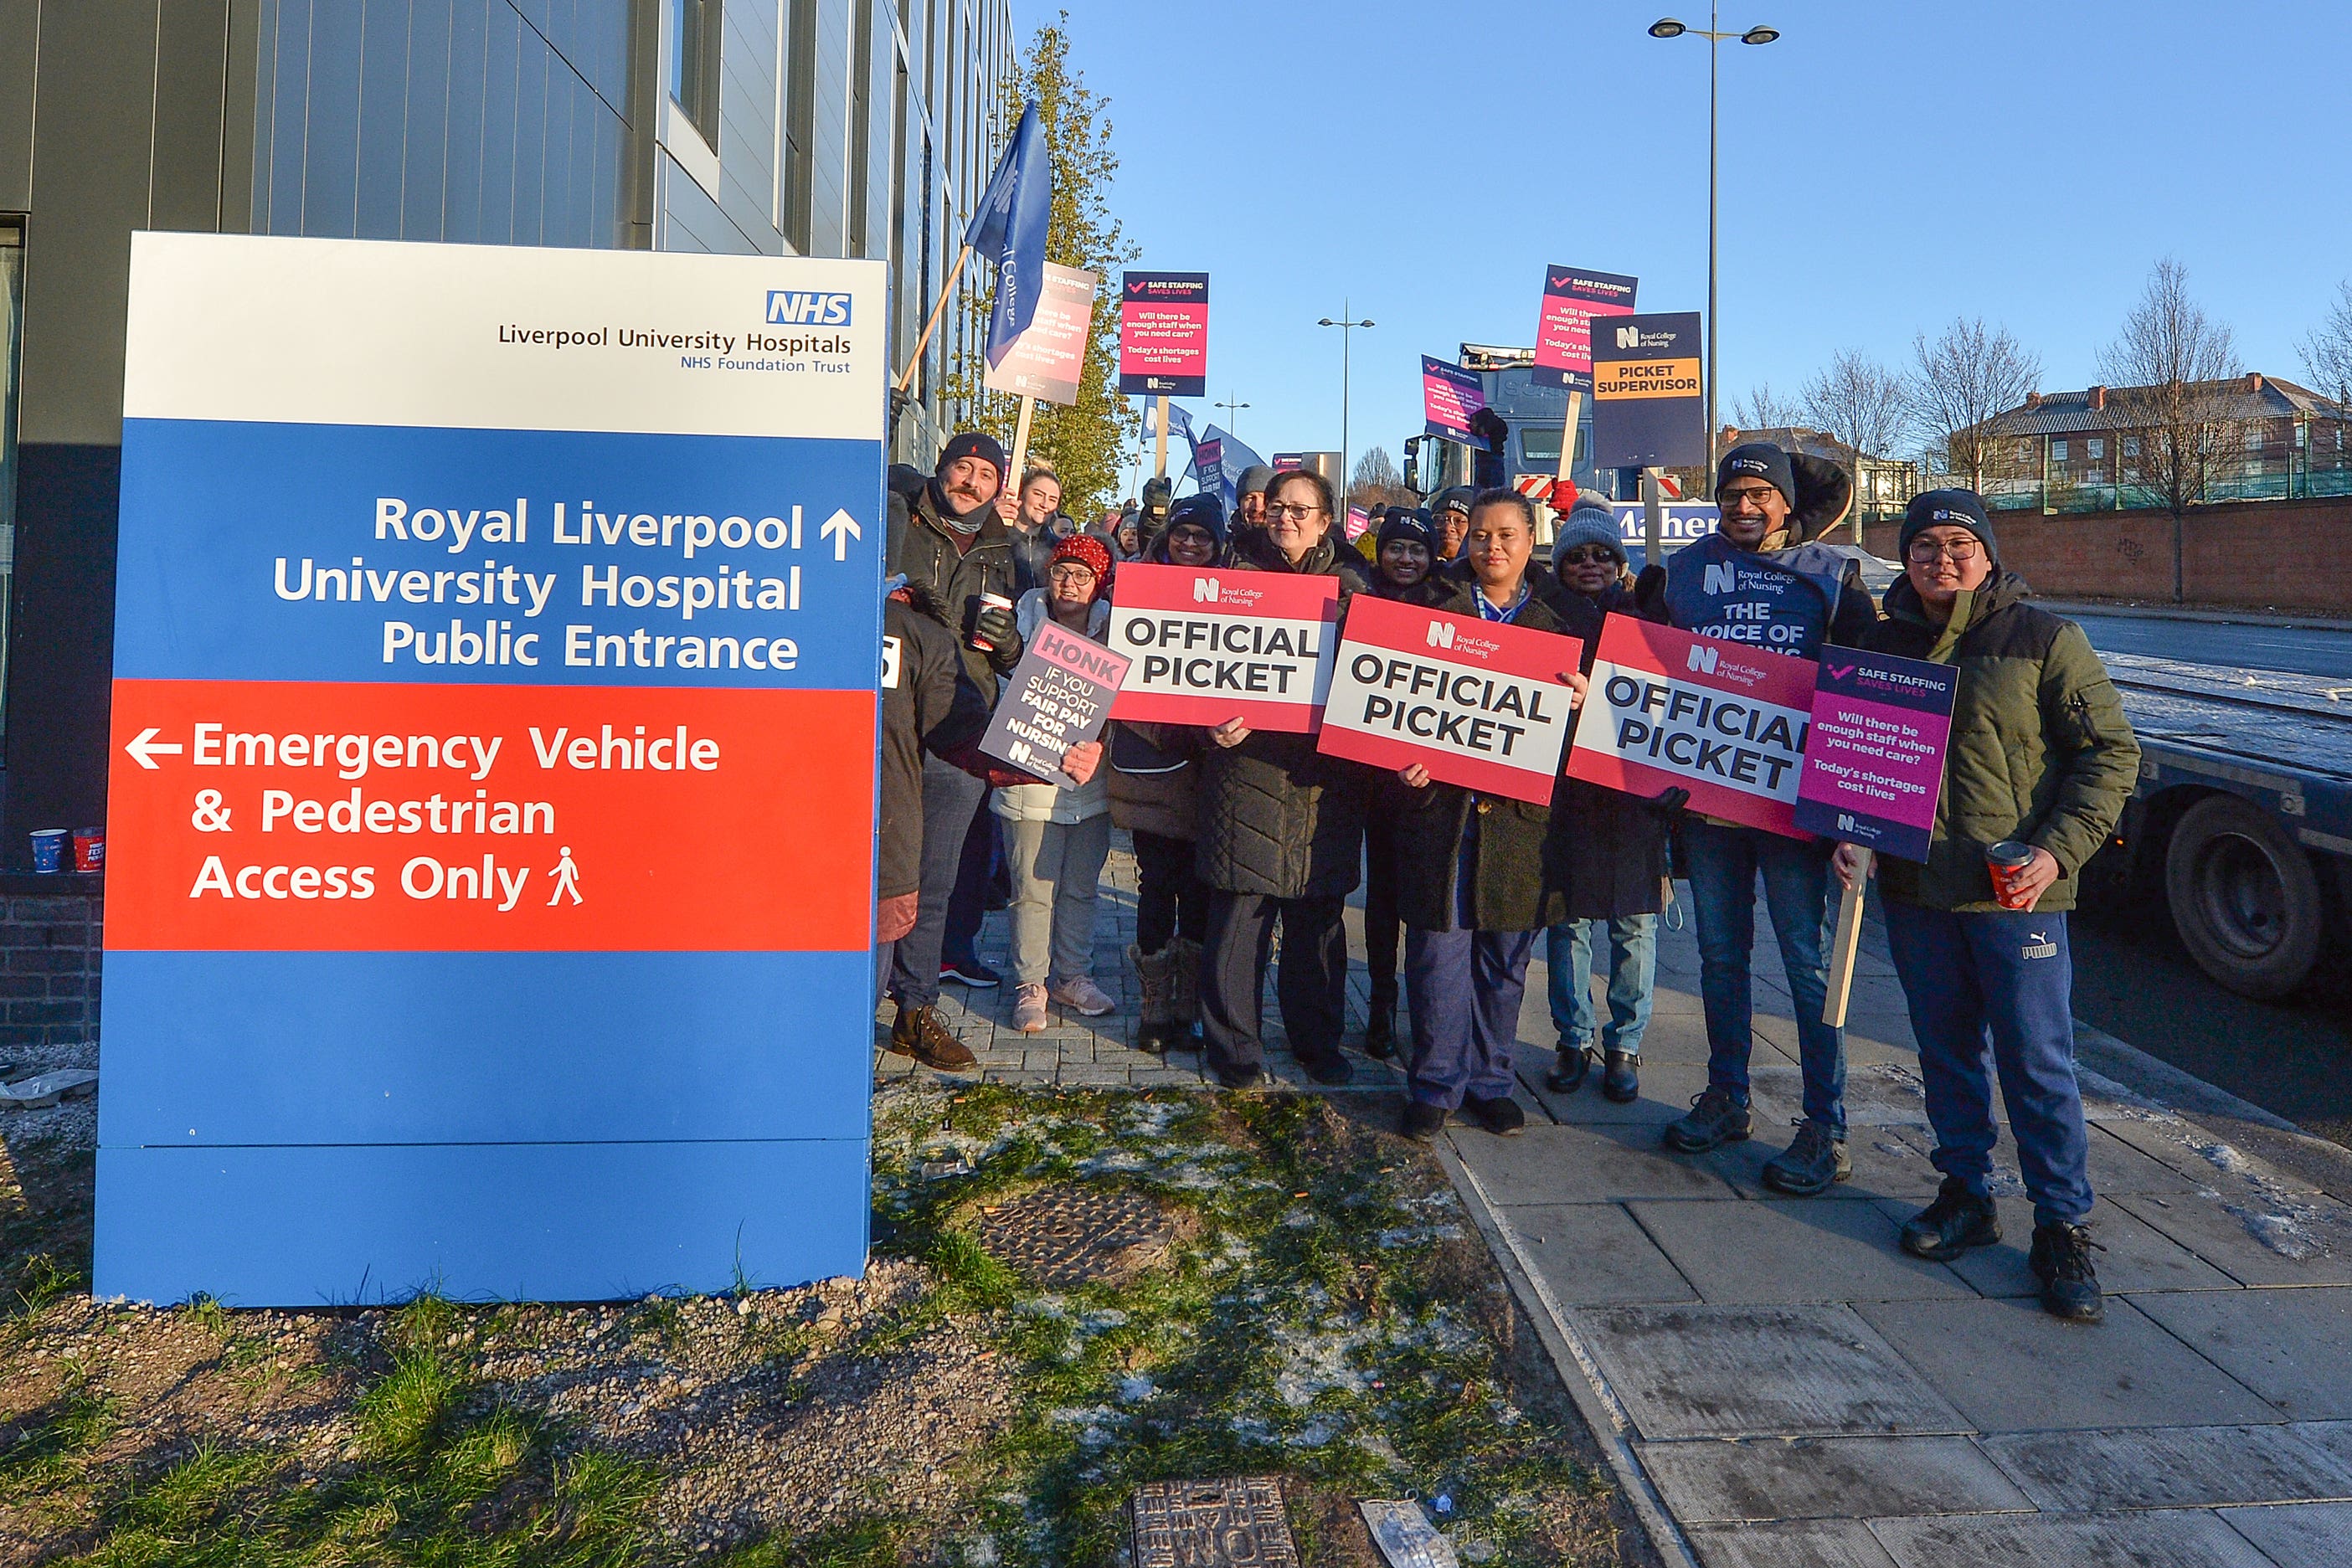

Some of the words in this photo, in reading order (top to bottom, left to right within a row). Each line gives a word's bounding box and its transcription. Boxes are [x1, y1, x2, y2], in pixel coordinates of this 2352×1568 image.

[1052, 276, 1089, 290] STAFFING
[1572, 278, 1593, 288] SAFE
[1594, 281, 1631, 293] STAFFING
[1001, 260, 1017, 328] College
[768, 293, 850, 324] NHS
[1060, 310, 1071, 321] be
[1560, 307, 1577, 316] Will
[1058, 321, 1081, 332] when
[1127, 321, 1157, 330] enough
[1546, 315, 1578, 326] enough
[1049, 328, 1072, 339] care?
[1553, 324, 1569, 333] you
[1571, 326, 1591, 335] nee
[1641, 333, 1656, 342] Royal
[1656, 332, 1676, 341] College
[498, 325, 608, 348] Liverpool
[618, 329, 735, 354] University
[747, 334, 851, 357] Hospitals
[1544, 338, 1576, 350] Today's
[1649, 340, 1669, 348] Nursing
[1033, 343, 1075, 359] shortages
[1037, 353, 1055, 365] lives
[1127, 347, 1157, 355] Today's
[1562, 350, 1579, 359] cost
[681, 357, 711, 368] NHS
[718, 357, 805, 372] Foundation
[812, 360, 850, 373] Trust
[1619, 365, 1674, 378] PICKET
[1598, 378, 1696, 392] SUPERVISOR
[374, 498, 526, 553] Royal
[553, 501, 801, 558] Liverpool
[1738, 570, 1762, 580] Royal
[1764, 571, 1797, 582] College
[274, 558, 556, 616] University
[582, 565, 800, 619] Hospital
[1222, 588, 1239, 596] Royal
[1240, 589, 1263, 599] College
[1738, 581, 1747, 591] of
[1748, 581, 1783, 594] Nursing
[1229, 596, 1253, 606] Nursing
[1723, 603, 1770, 619] THE
[1125, 617, 1320, 658] OFFICIAL
[1691, 625, 1762, 640] VOICE
[1768, 625, 1804, 642] OF
[382, 619, 538, 666] Public
[565, 625, 798, 670] Entrance
[1457, 635, 1475, 646] Royal
[1475, 639, 1500, 651] College
[1042, 635, 1120, 683] HONK
[1464, 645, 1488, 659] Nursing
[1143, 655, 1297, 693] PICKET
[1720, 661, 1740, 671] Royal
[1740, 665, 1767, 679] College
[1727, 671, 1753, 686] Nursing
[1045, 666, 1062, 680] IF
[1062, 673, 1094, 697] YOU
[1857, 677, 1891, 690] SAVES
[1895, 683, 1926, 697] LIVES
[1858, 668, 1887, 681] SAFE
[1890, 673, 1946, 691] STAFFING
[1027, 676, 1099, 716] SUPPORT
[1351, 654, 1552, 724] OFFICIAL
[1021, 690, 1058, 717] FAIR
[1058, 707, 1092, 730] PAY
[1032, 712, 1067, 737] FOR
[1363, 694, 1525, 756] PICKET
[1839, 712, 1862, 725] Will
[1866, 716, 1899, 733] there
[1902, 725, 1918, 737] be
[1006, 718, 1071, 755] NURSIN
[1818, 722, 1864, 740] enough
[1866, 732, 1896, 746] staff
[1899, 740, 1935, 754] when
[193, 722, 502, 780] Emergency
[528, 724, 720, 771] Vehicle
[1618, 718, 1793, 789] PICKET
[1827, 738, 1850, 748] you
[1852, 743, 1884, 757] need
[1886, 751, 1921, 764] care?
[1814, 758, 1860, 779] Today's
[1862, 772, 1926, 794] shortages
[1838, 780, 1864, 794] cost
[1866, 786, 1896, 800] lives
[191, 789, 232, 833] &
[262, 788, 554, 834] Pedestrian
[190, 856, 375, 900] Access
[400, 854, 529, 912] Only
